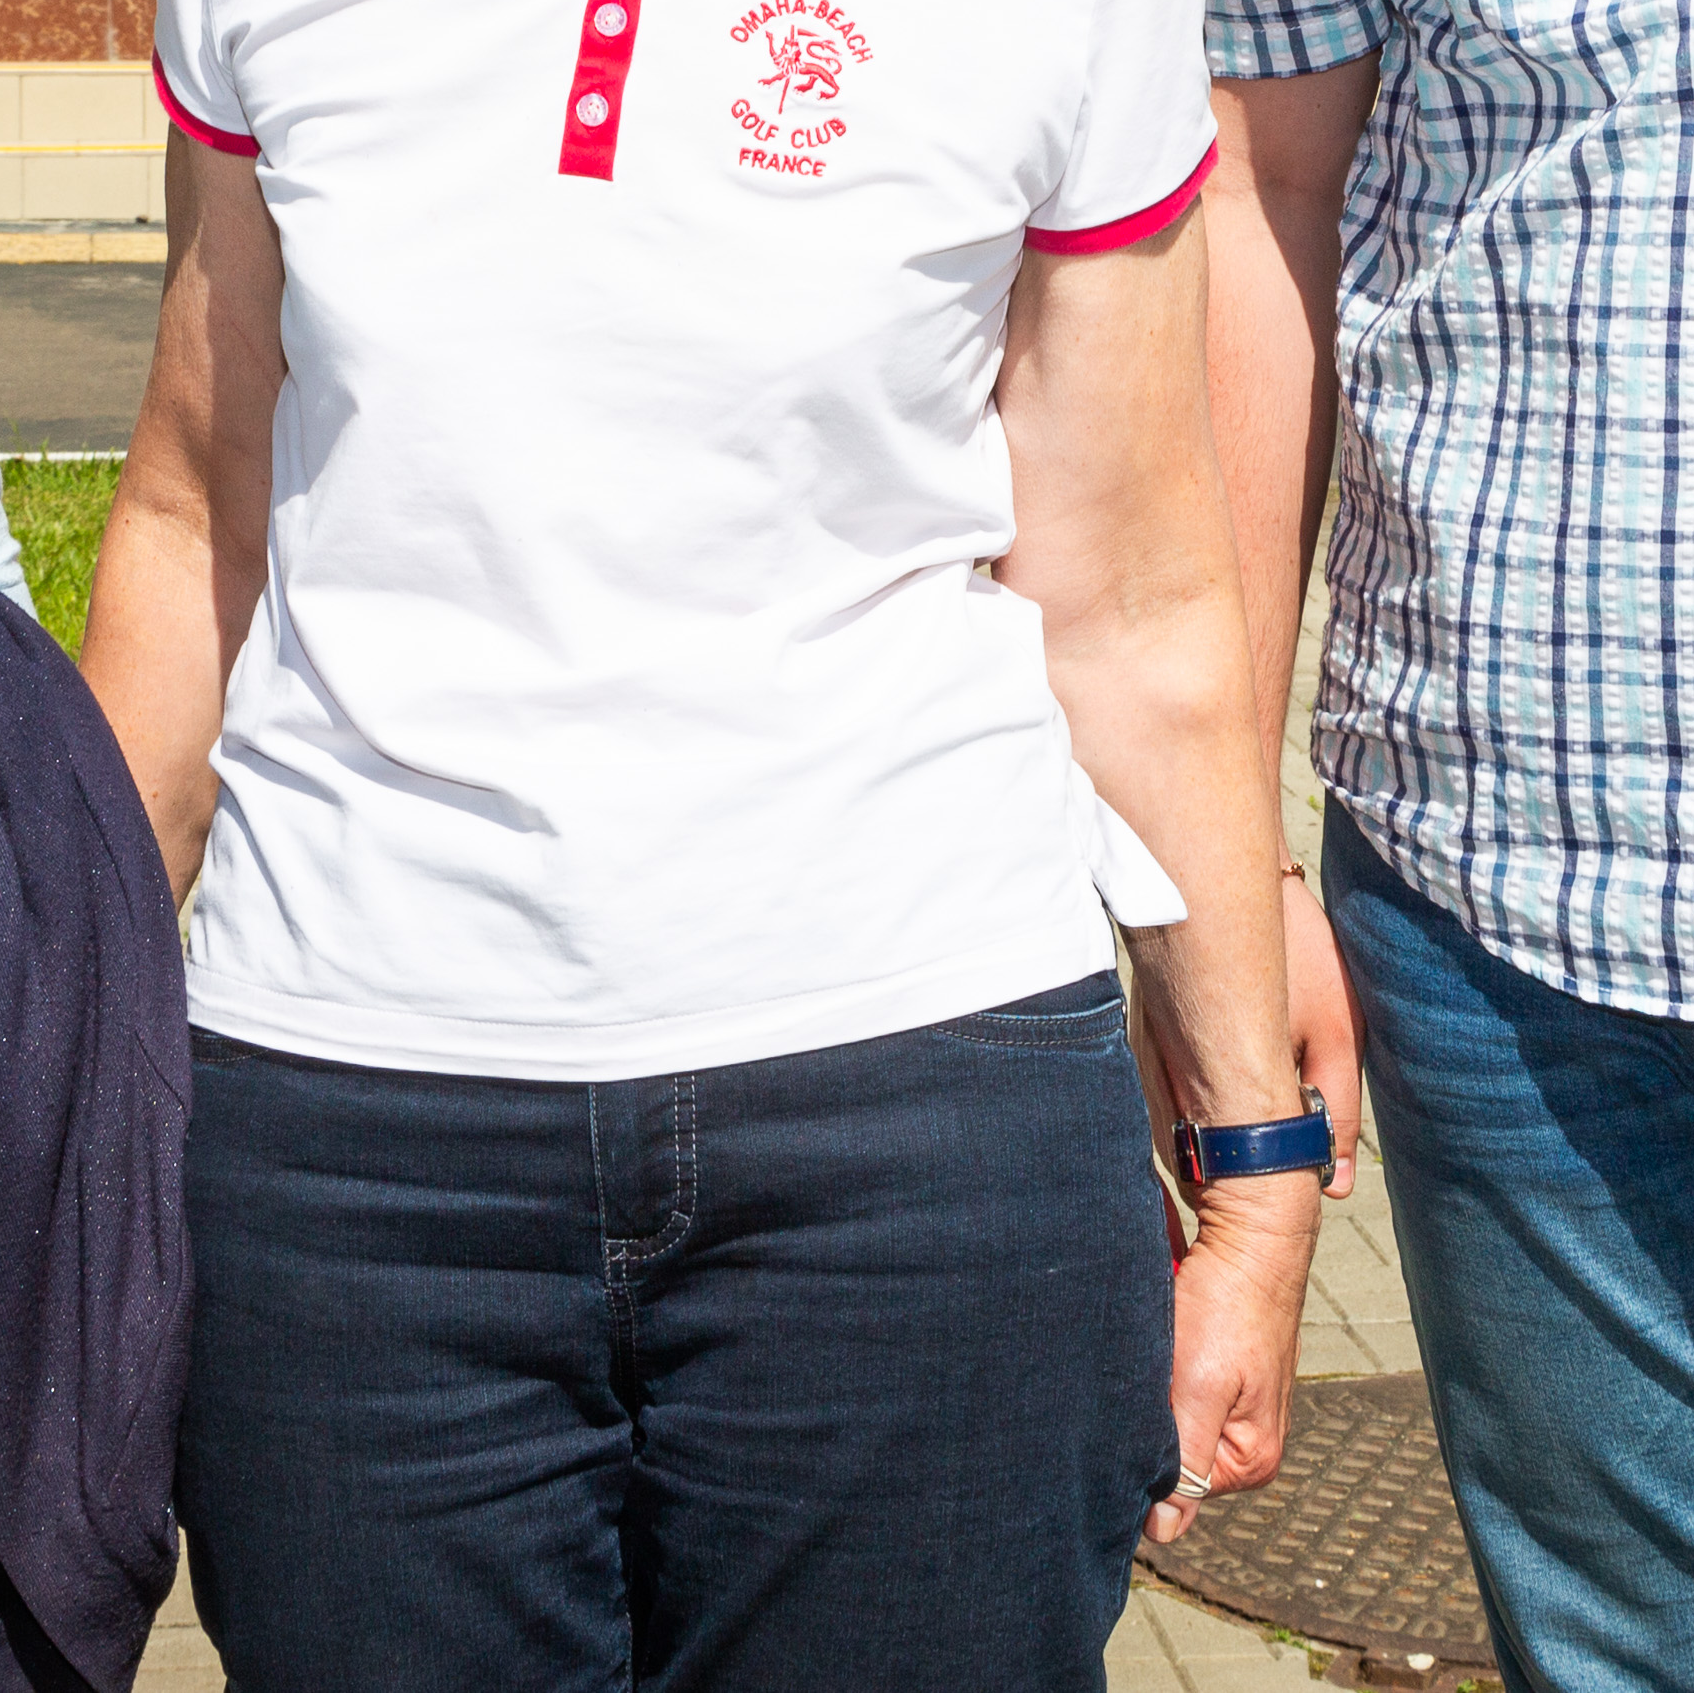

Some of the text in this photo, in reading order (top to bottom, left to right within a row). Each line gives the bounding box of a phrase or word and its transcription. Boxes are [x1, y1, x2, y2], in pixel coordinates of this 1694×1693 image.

[731, 98, 847, 149] GOLF CLUB
[739, 147, 827, 178] FRANCE
